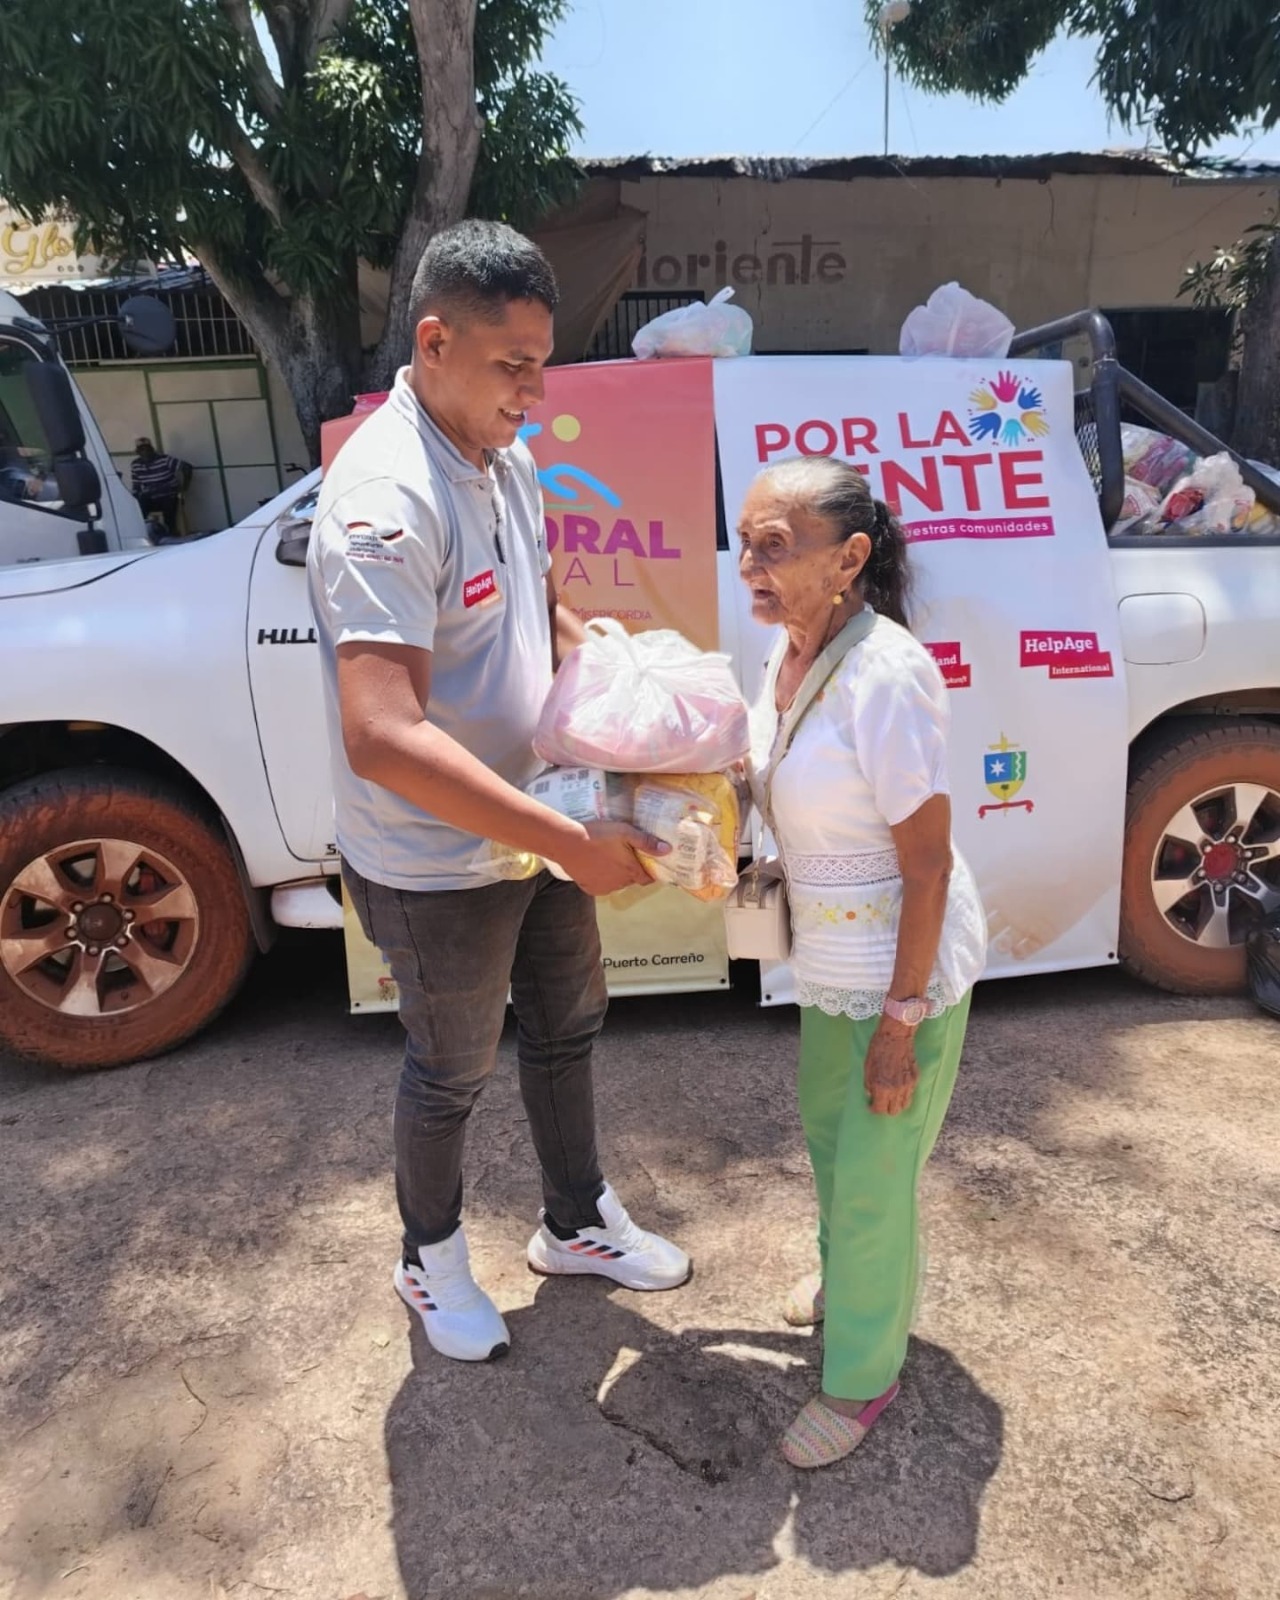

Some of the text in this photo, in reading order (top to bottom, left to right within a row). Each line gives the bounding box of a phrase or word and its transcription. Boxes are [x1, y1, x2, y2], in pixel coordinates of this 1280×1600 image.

[2, 222, 95, 275] Glo
[755, 410, 972, 463] POR LA
[854, 450, 1050, 516] NTE
[904, 520, 1049, 538] uestras comunidades
[1024, 636, 1093, 654] HelpAge
[1051, 664, 1110, 675] International
[602, 952, 705, 969] Puerto Carreño
